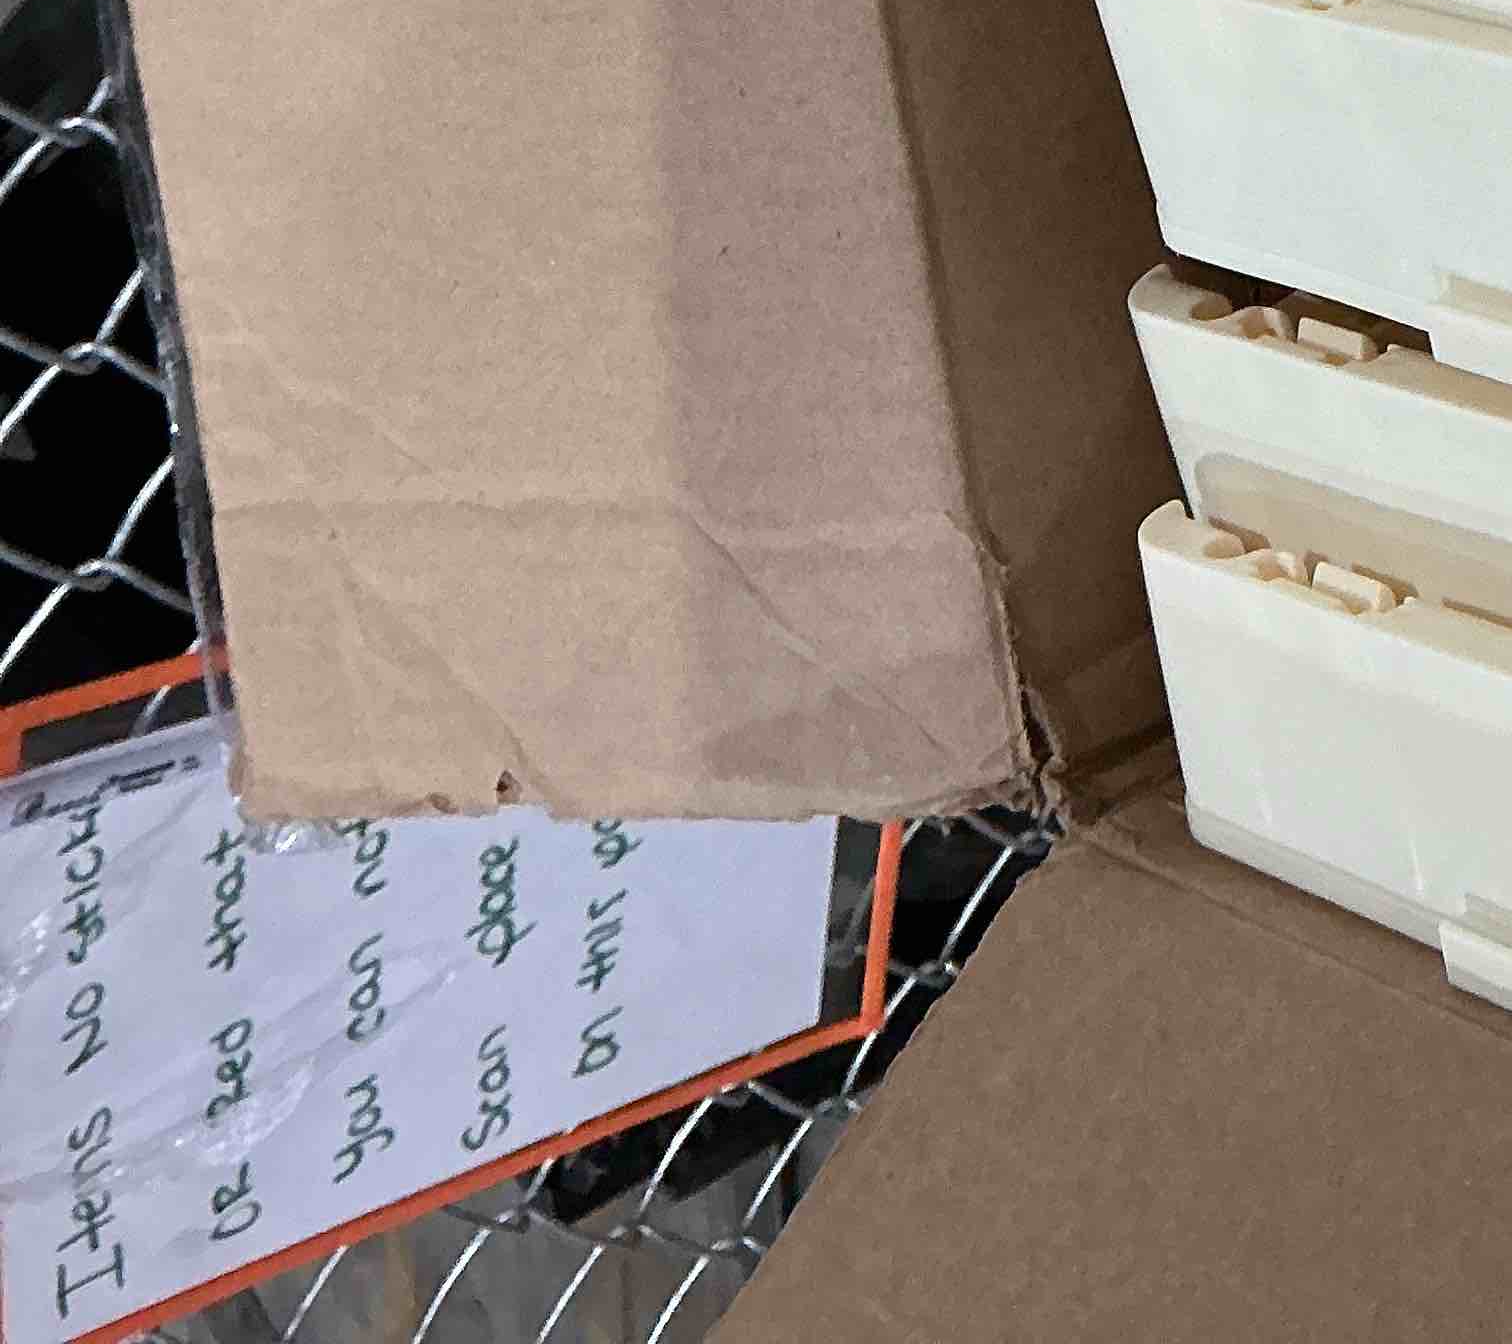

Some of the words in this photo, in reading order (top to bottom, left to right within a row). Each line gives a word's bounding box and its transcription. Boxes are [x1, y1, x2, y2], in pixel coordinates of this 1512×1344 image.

[202, 828, 248, 973] that
[463, 835, 539, 968] place
[346, 932, 387, 1042] can
[333, 1073, 395, 1185] you
